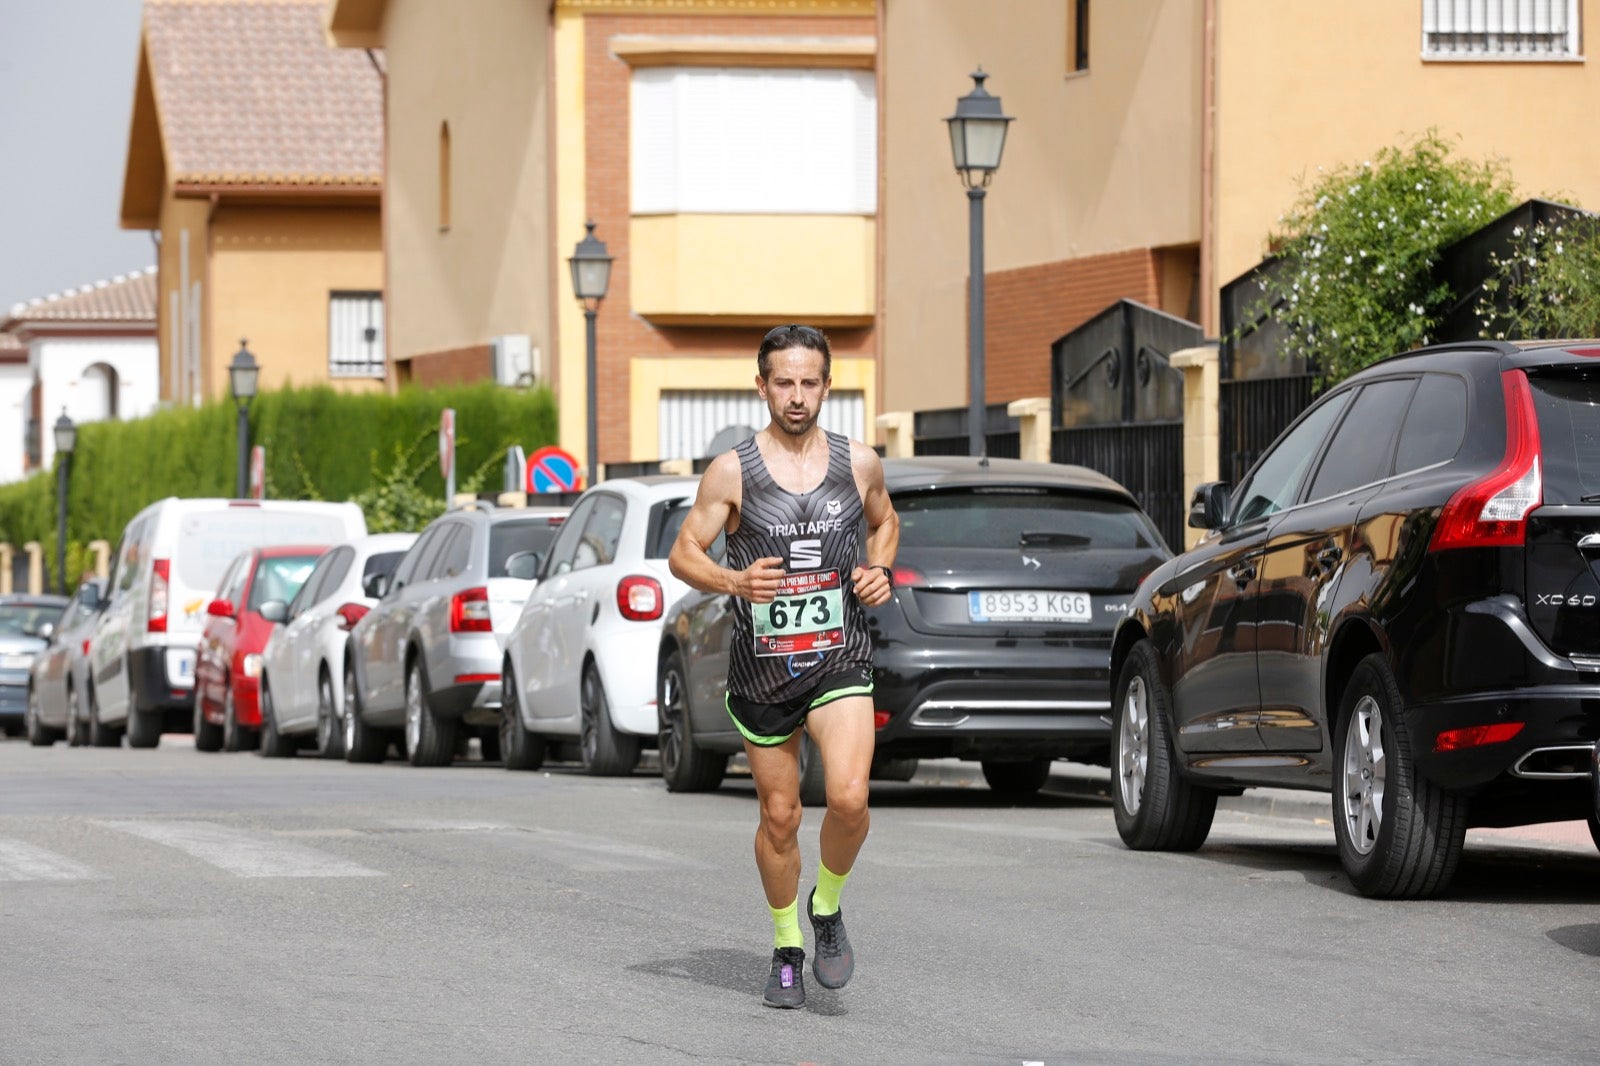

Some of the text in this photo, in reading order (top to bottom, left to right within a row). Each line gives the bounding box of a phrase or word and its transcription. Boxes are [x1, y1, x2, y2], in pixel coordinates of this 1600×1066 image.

[767, 519, 842, 537] TRIATARFE
[786, 575, 808, 587] PREMIO
[809, 573, 817, 584] DE
[985, 594, 1086, 614] 8953 KGG
[1535, 594, 1596, 606] XC60
[769, 595, 831, 629] 673
